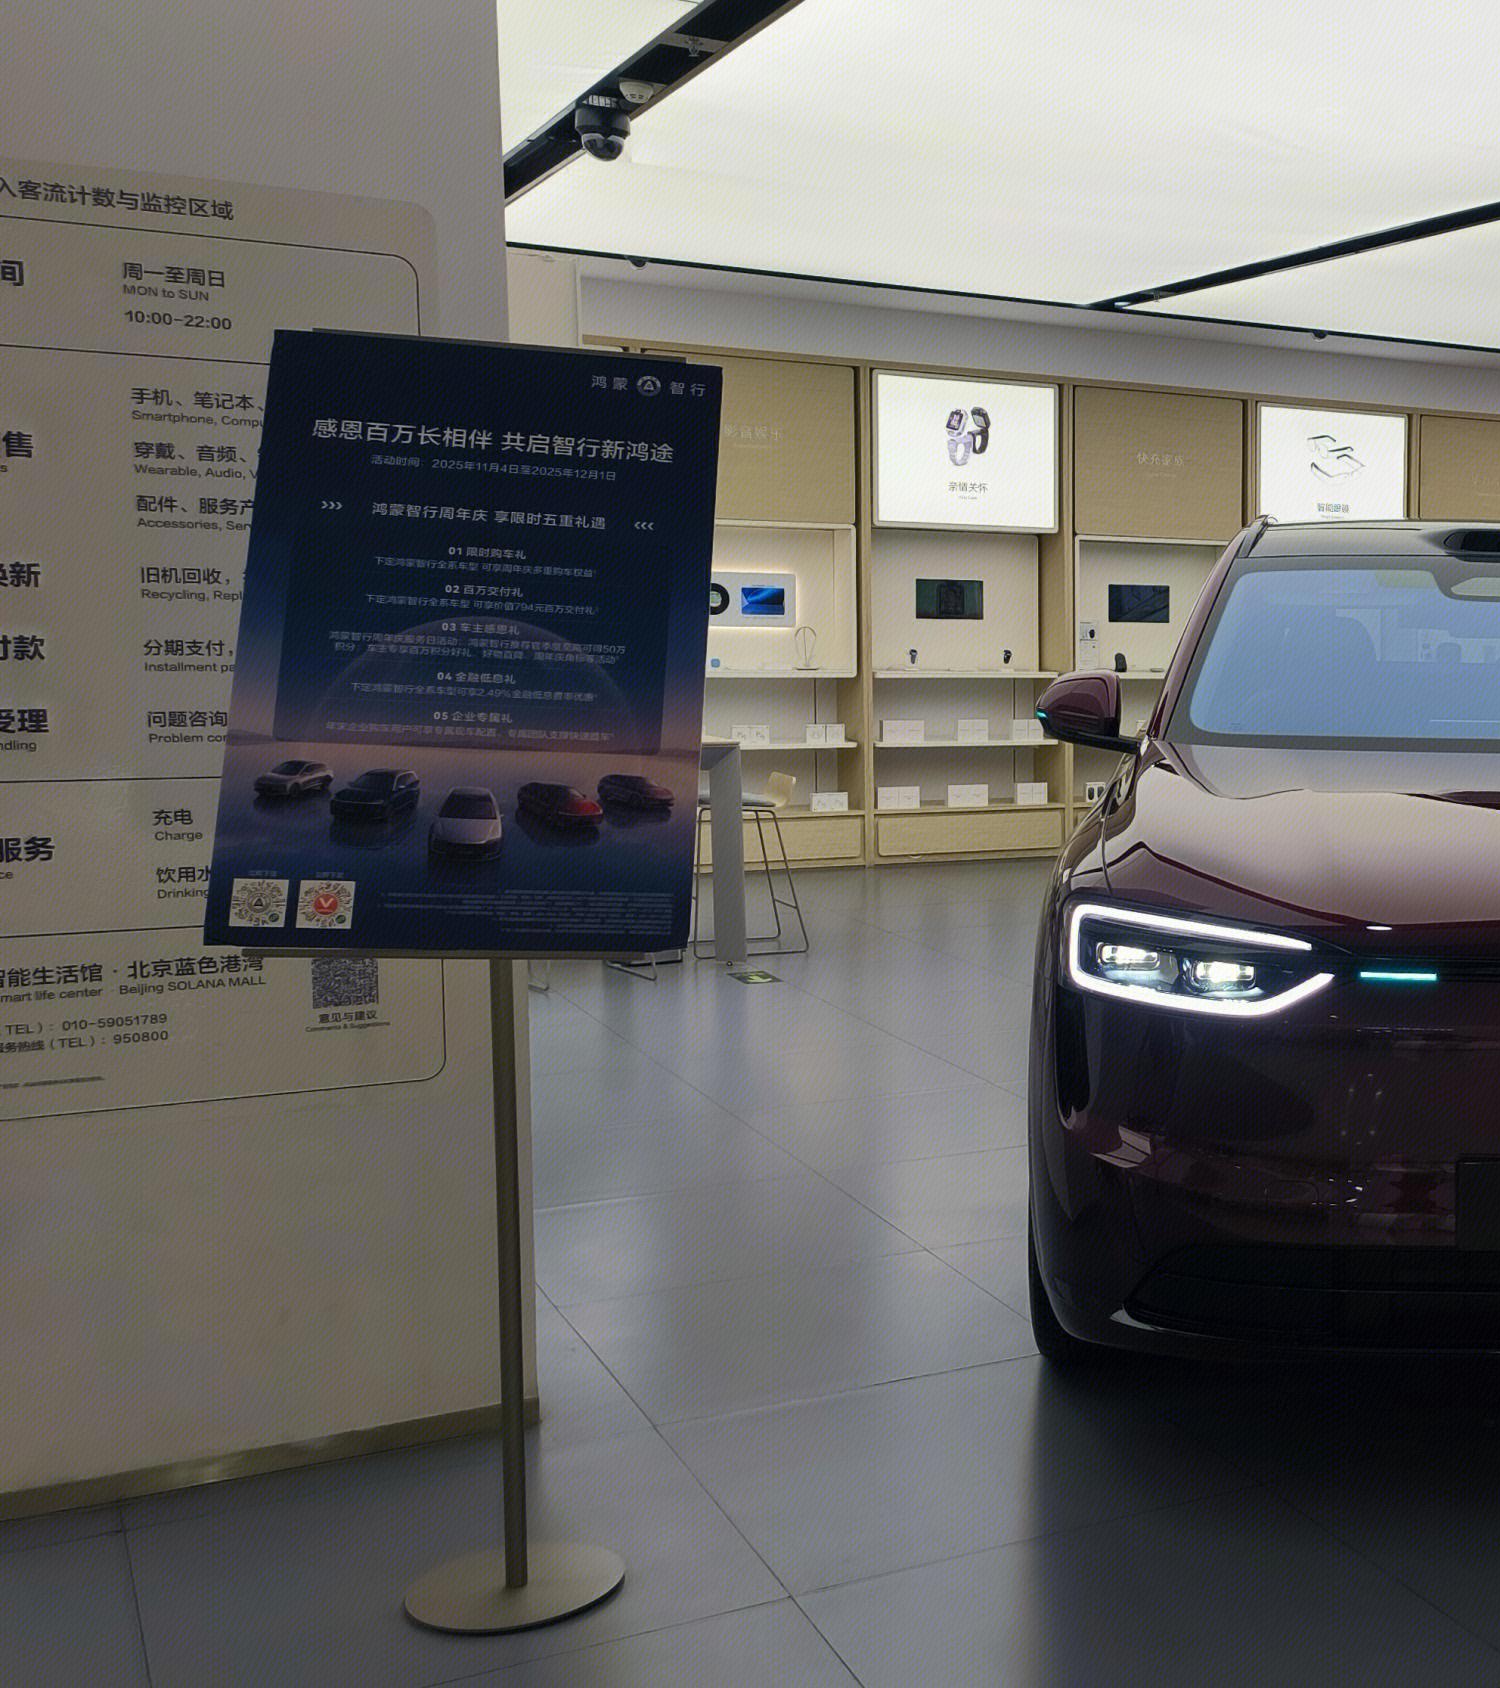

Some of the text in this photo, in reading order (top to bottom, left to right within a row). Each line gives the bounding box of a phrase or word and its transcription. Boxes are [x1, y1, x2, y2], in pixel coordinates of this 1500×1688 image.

[123, 262, 226, 288] 周一至周日
[122, 284, 210, 302] MON to SUN
[124, 309, 233, 331] 10:00-22:00
[131, 409, 217, 426] Smartphone,
[312, 417, 675, 465] 感恩百万长相伴 共启智行新鸿途
[133, 464, 202, 481] Wearable,
[204, 471, 246, 485] Audio,
[373, 501, 607, 531] 鸿蒙智行周年庆 享限时五重礼遇
[136, 517, 222, 532] Accessories,
[448, 546, 527, 560] 01 限时购车礼
[141, 589, 210, 604] Recycling,
[445, 584, 524, 598] 02 百万交付礼
[442, 622, 520, 636] 03 车主感恩礼
[144, 661, 219, 675] Installment
[437, 671, 516, 685] 04 金融低息礼
[147, 710, 229, 733] 问题咨询
[433, 710, 513, 724] 05 企业专属礼
[149, 732, 202, 744] Problem
[152, 807, 194, 827] 充电
[155, 830, 204, 842] Charge
[35, 990, 56, 1001] life
[59, 986, 103, 1000] center
[119, 983, 164, 996] Beijing
[168, 979, 225, 992] SOLANA
[228, 975, 266, 987] MALL
[318, 1010, 378, 1024] 意见与建议
